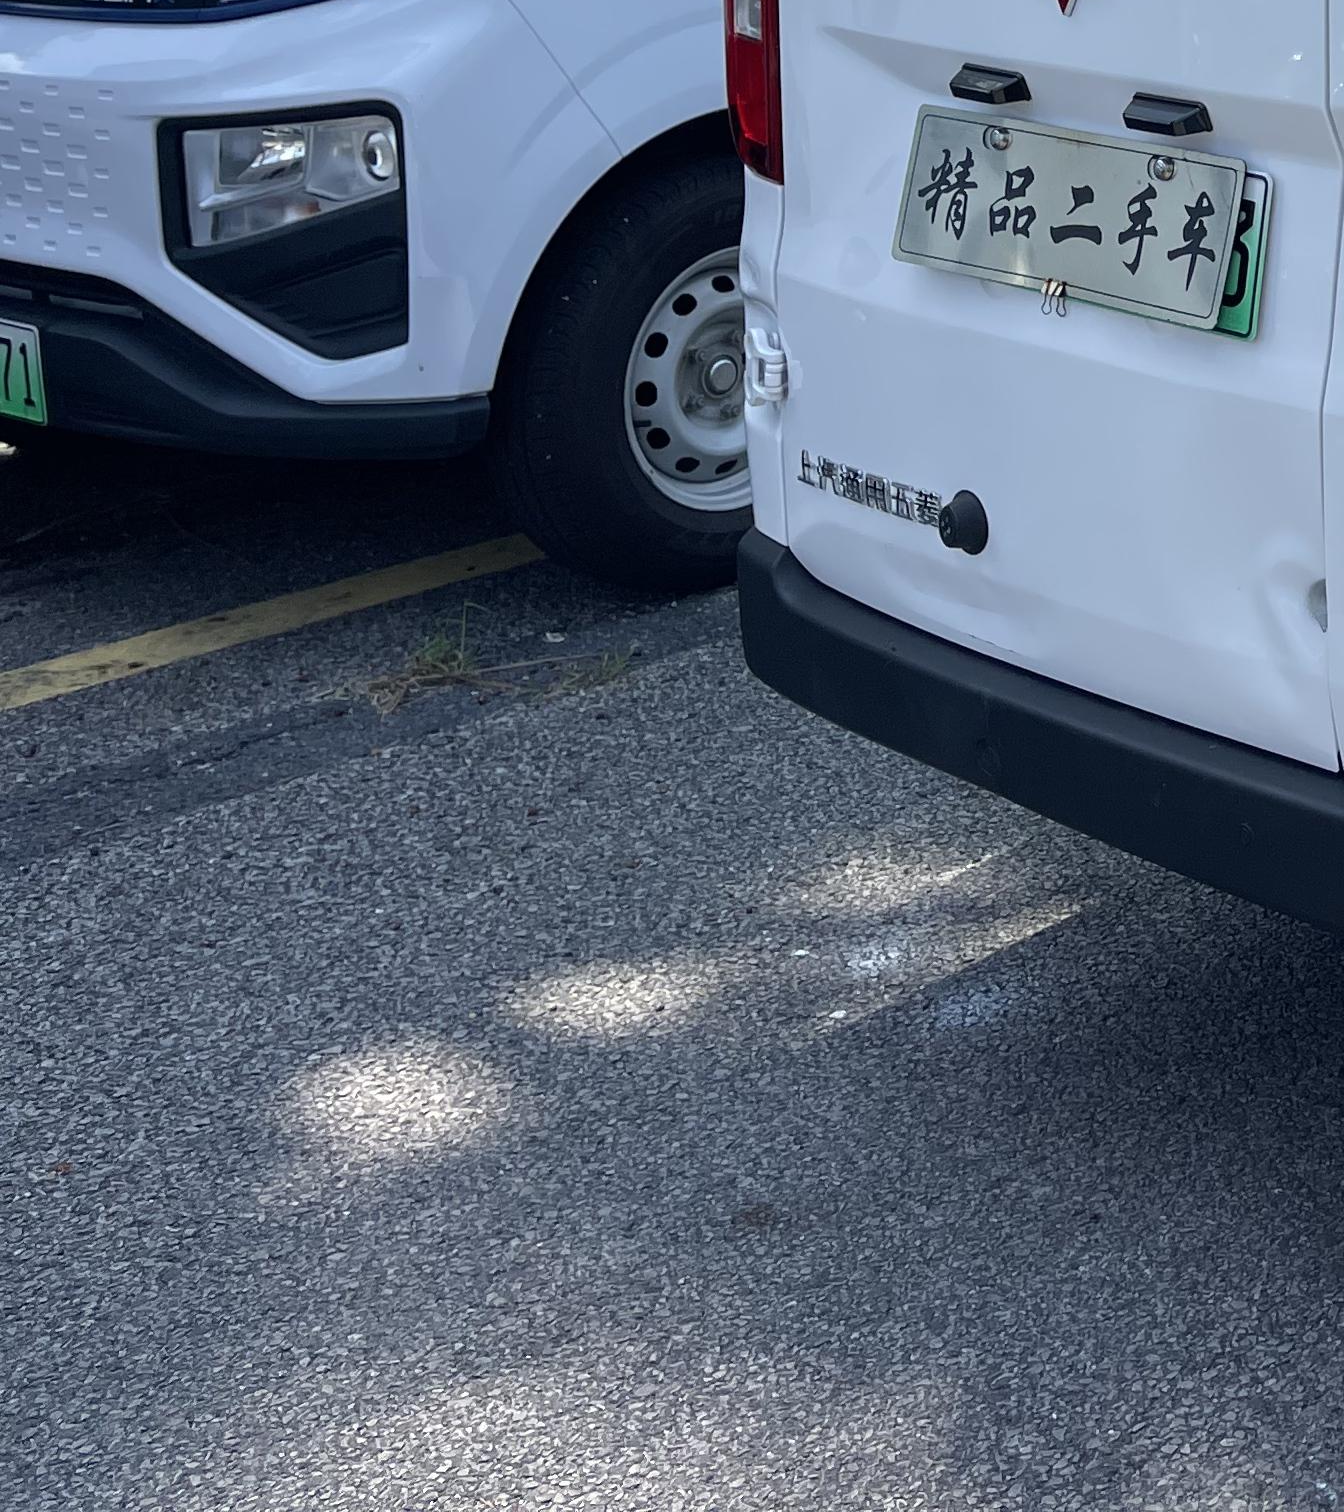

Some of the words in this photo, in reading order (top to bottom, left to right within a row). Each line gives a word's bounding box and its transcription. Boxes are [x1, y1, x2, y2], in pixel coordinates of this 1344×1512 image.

[917, 146, 1217, 292] 精品二手车
[796, 448, 943, 528] 上汽通用五菱
